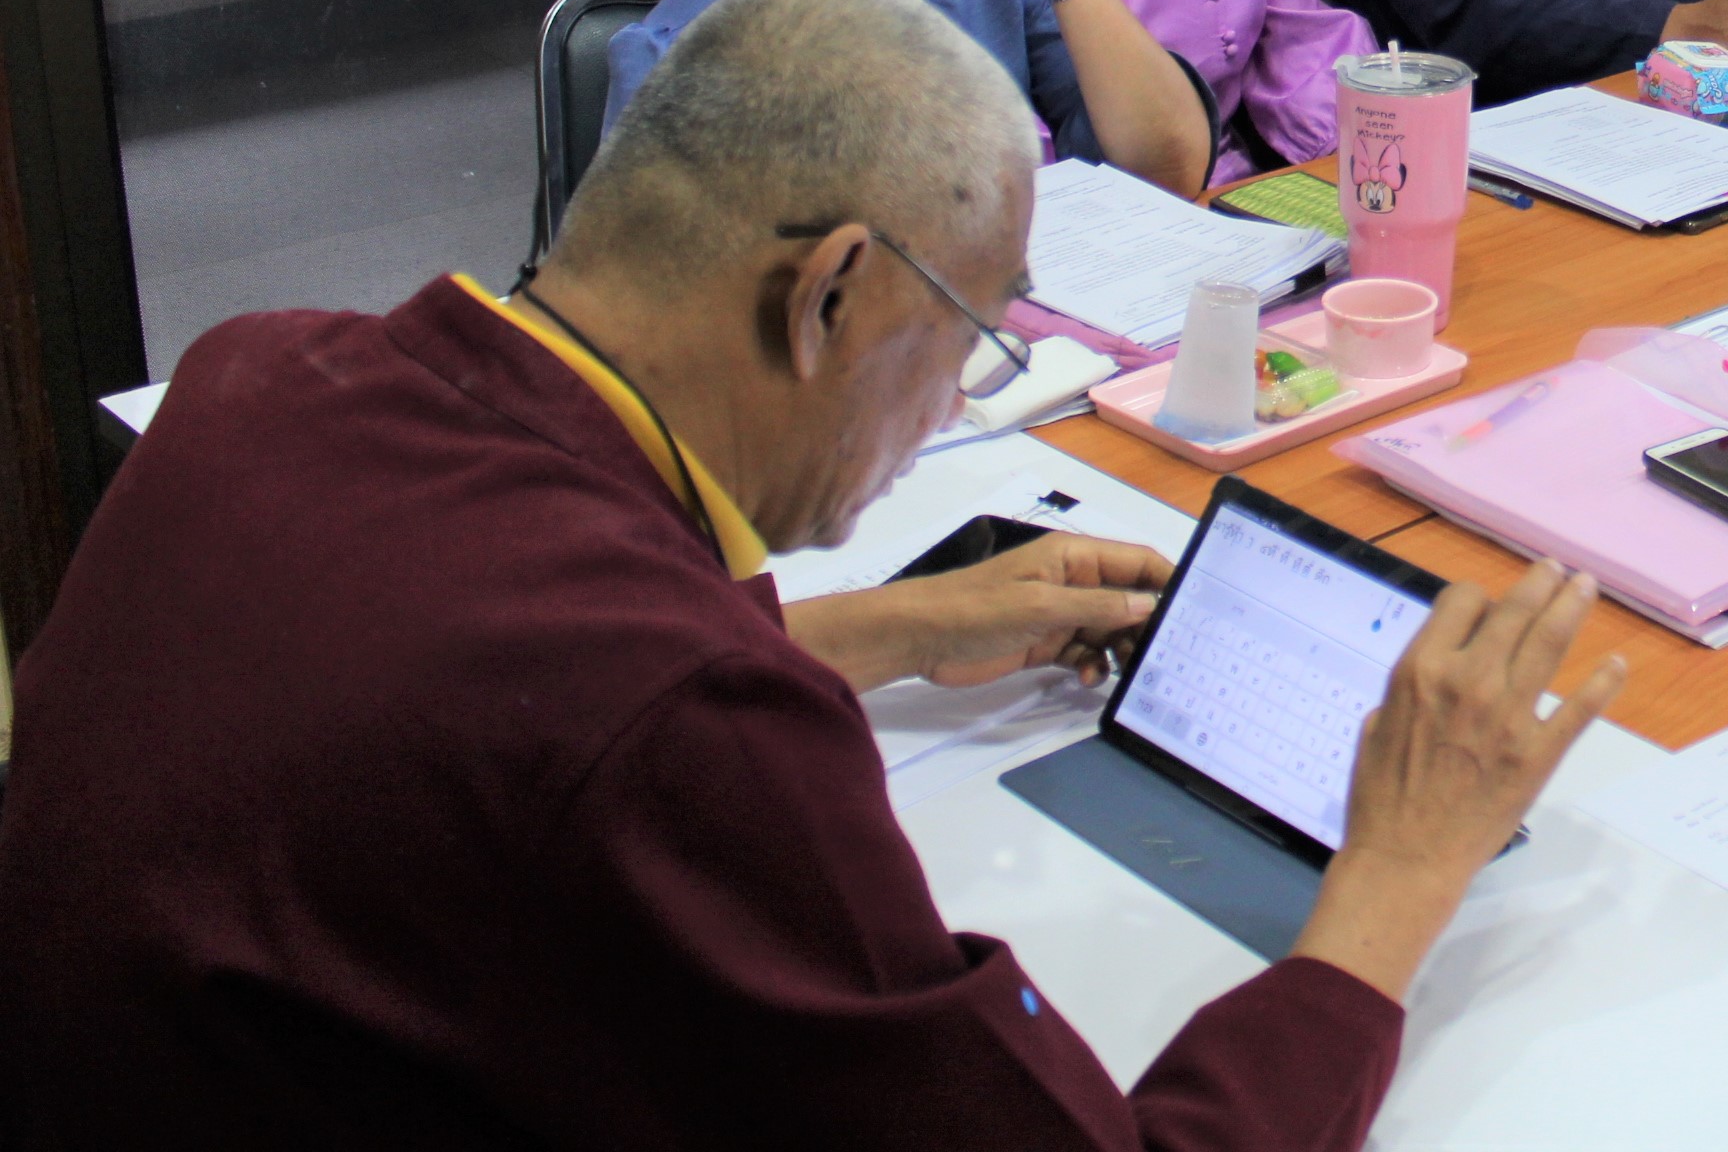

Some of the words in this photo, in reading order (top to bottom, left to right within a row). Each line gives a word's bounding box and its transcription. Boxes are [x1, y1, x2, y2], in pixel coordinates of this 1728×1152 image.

[1355, 106, 1396, 120] Anyone
[1365, 121, 1394, 130] seen
[1357, 129, 1405, 143] Mickey?
